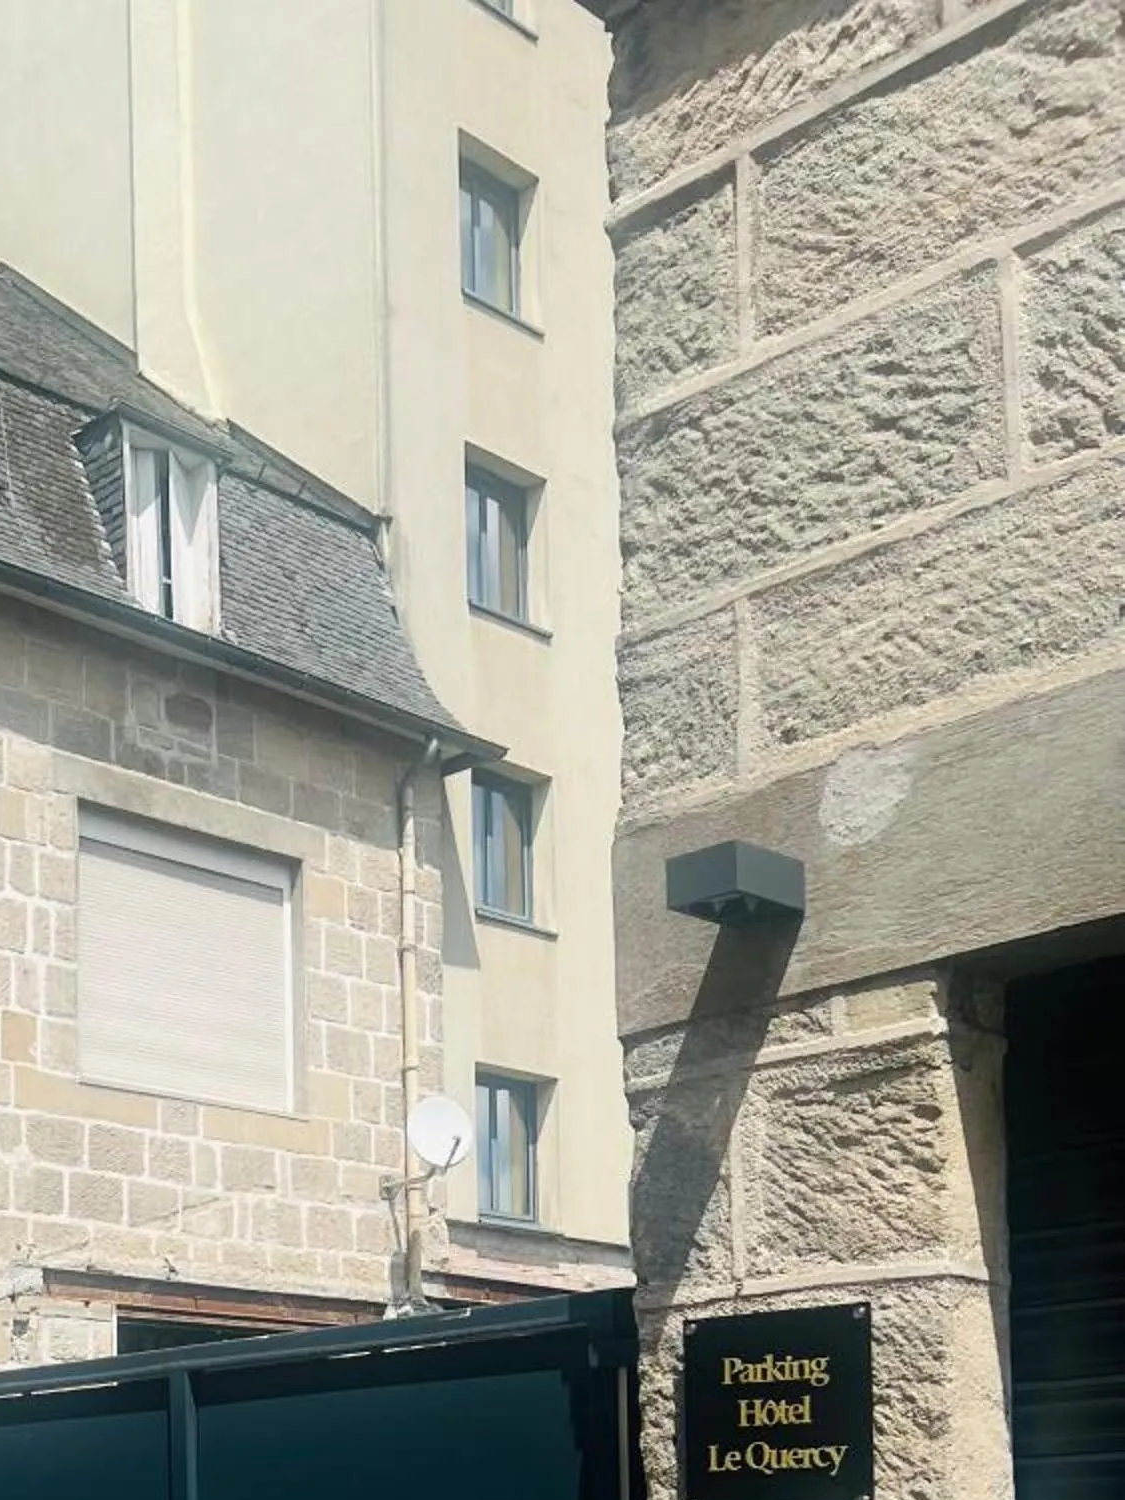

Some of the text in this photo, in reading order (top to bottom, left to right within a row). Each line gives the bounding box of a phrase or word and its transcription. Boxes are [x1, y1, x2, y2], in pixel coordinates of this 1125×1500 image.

[721, 1353, 831, 1388] Parking
[738, 1395, 812, 1427] Hôtel
[708, 1441, 849, 1476] Le Quercy
